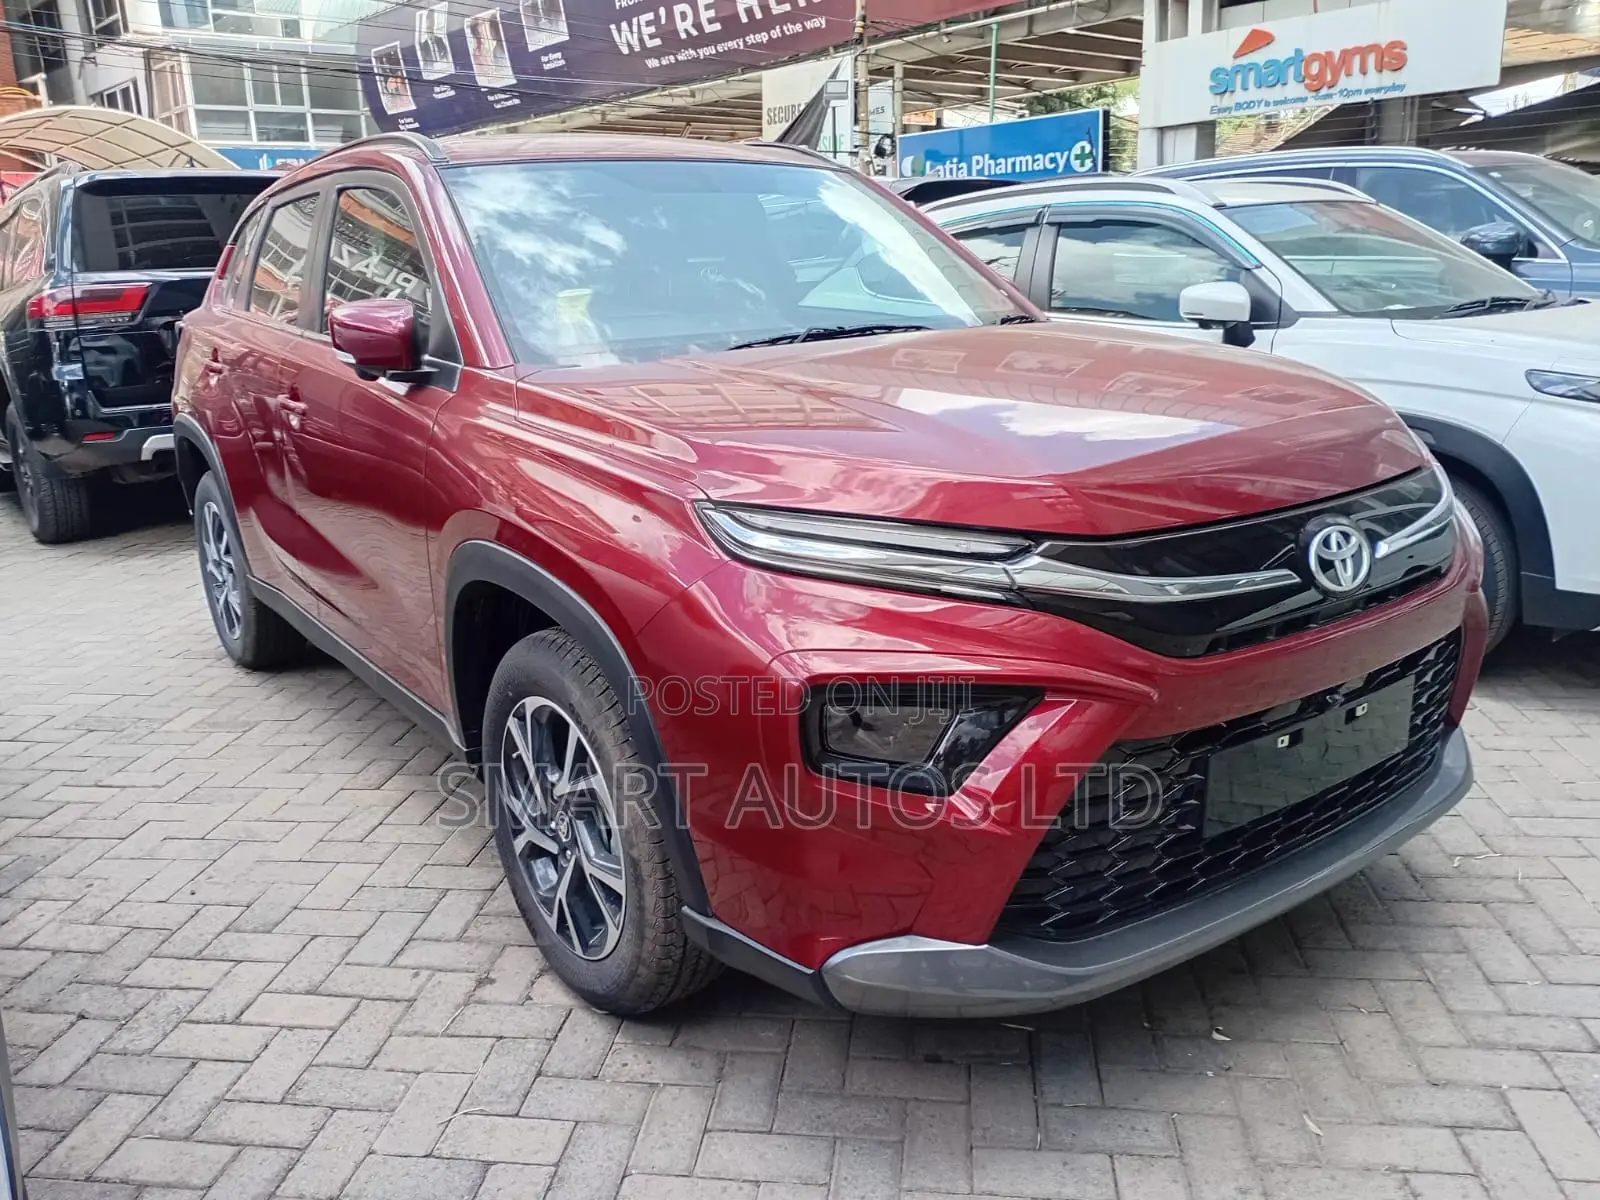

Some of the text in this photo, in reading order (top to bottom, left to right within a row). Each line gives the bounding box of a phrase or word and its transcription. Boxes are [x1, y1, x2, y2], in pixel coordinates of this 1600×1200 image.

[609, 0, 722, 55] WE'RE
[645, 16, 827, 69] We are with you every step of the way
[1209, 40, 1408, 95] smartgyms
[1234, 99, 1264, 112] BODY
[972, 149, 1069, 178] Pharmacy
